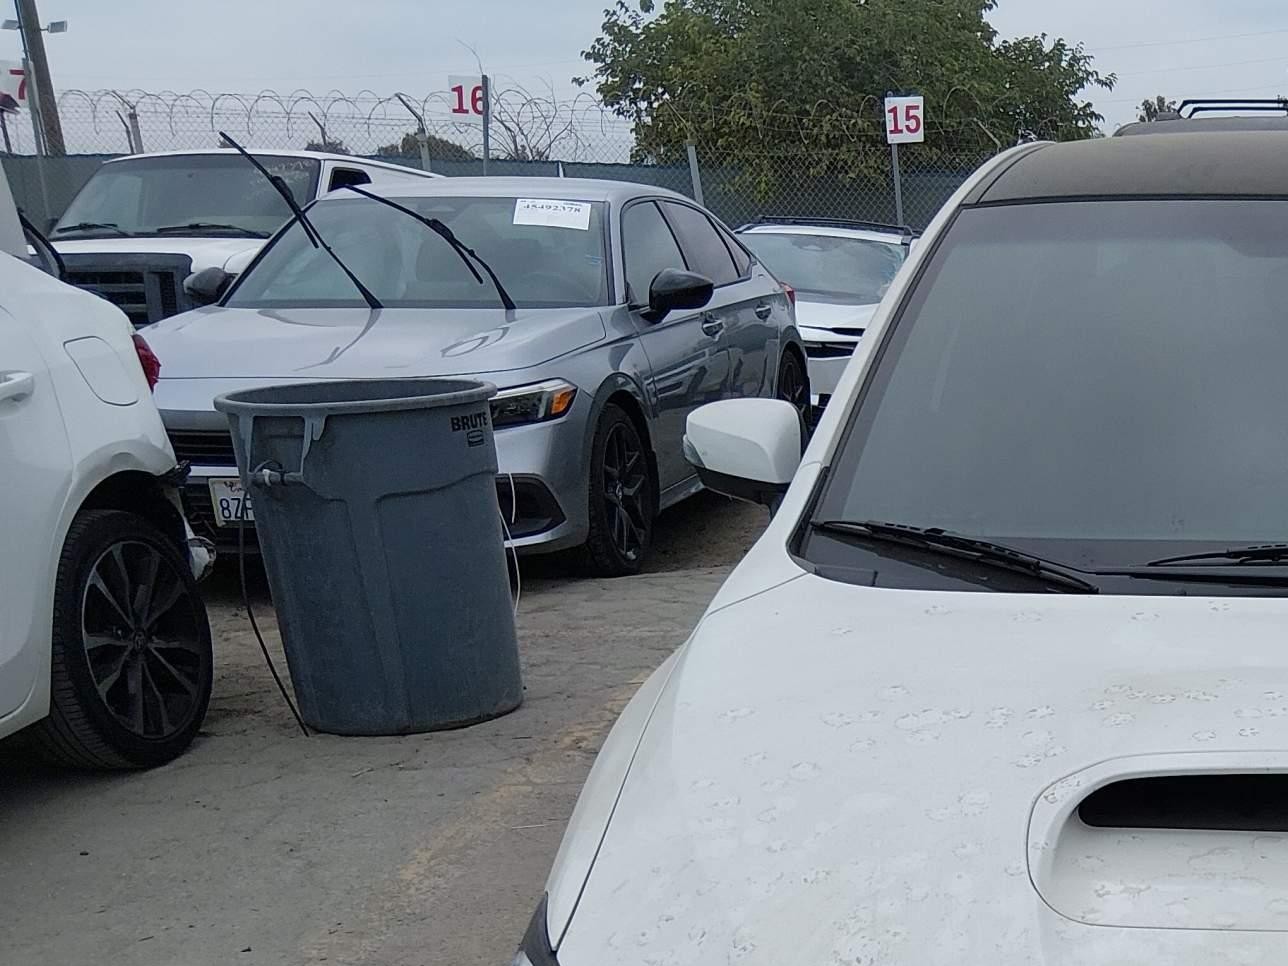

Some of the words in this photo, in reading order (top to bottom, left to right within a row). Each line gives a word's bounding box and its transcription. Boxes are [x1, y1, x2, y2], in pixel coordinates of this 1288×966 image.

[451, 85, 484, 116] 16
[887, 104, 921, 134] 15
[450, 411, 488, 432] BRUTE
